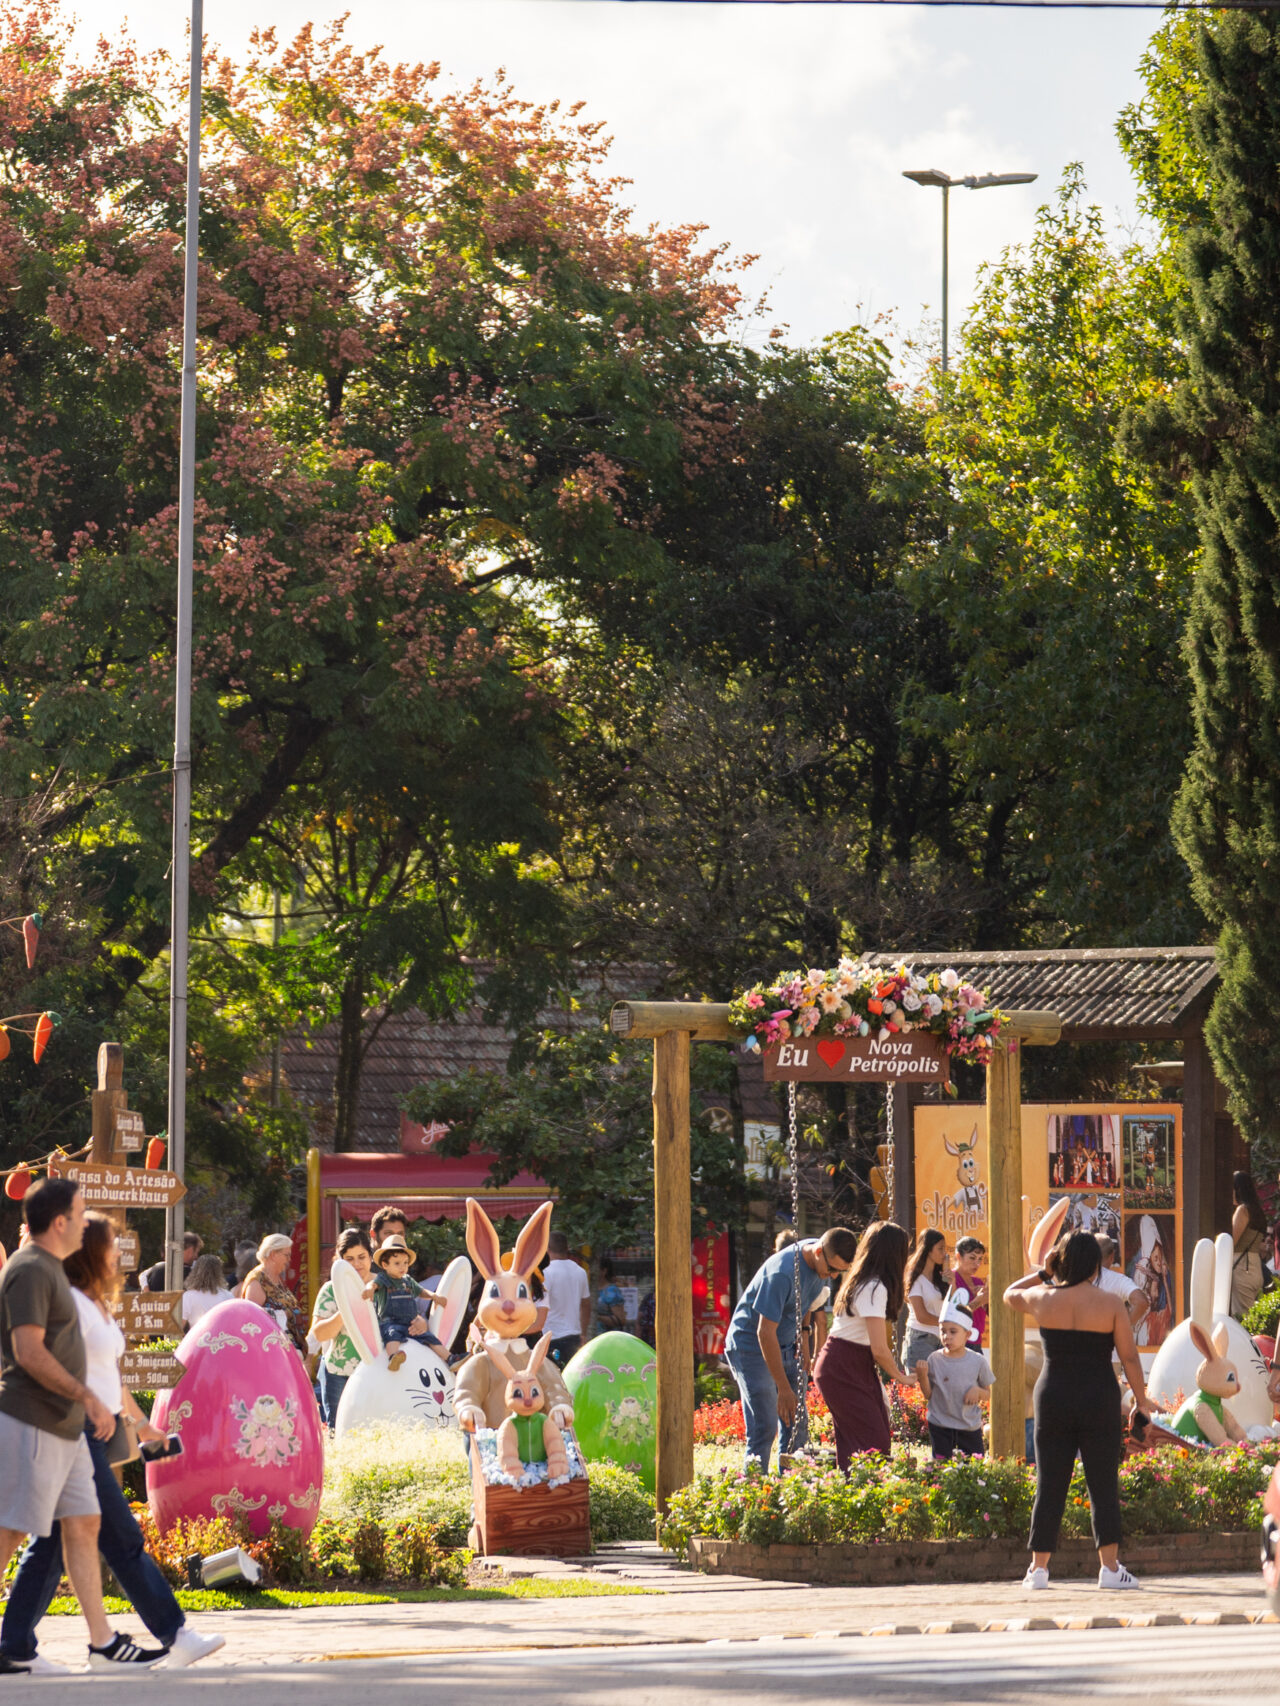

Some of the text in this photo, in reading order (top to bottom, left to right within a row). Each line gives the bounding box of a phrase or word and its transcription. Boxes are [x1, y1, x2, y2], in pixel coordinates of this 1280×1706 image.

[776, 1044, 809, 1067] Eu
[868, 1039, 913, 1055] Nova
[849, 1055, 940, 1076] Petrópolis
[67, 1168, 176, 1188] Casa do Artesão
[922, 1190, 979, 1241] Magia
[130, 1295, 170, 1315] Águias
[136, 1354, 177, 1370] Imigrante
[147, 1372, 169, 1384] 500m
